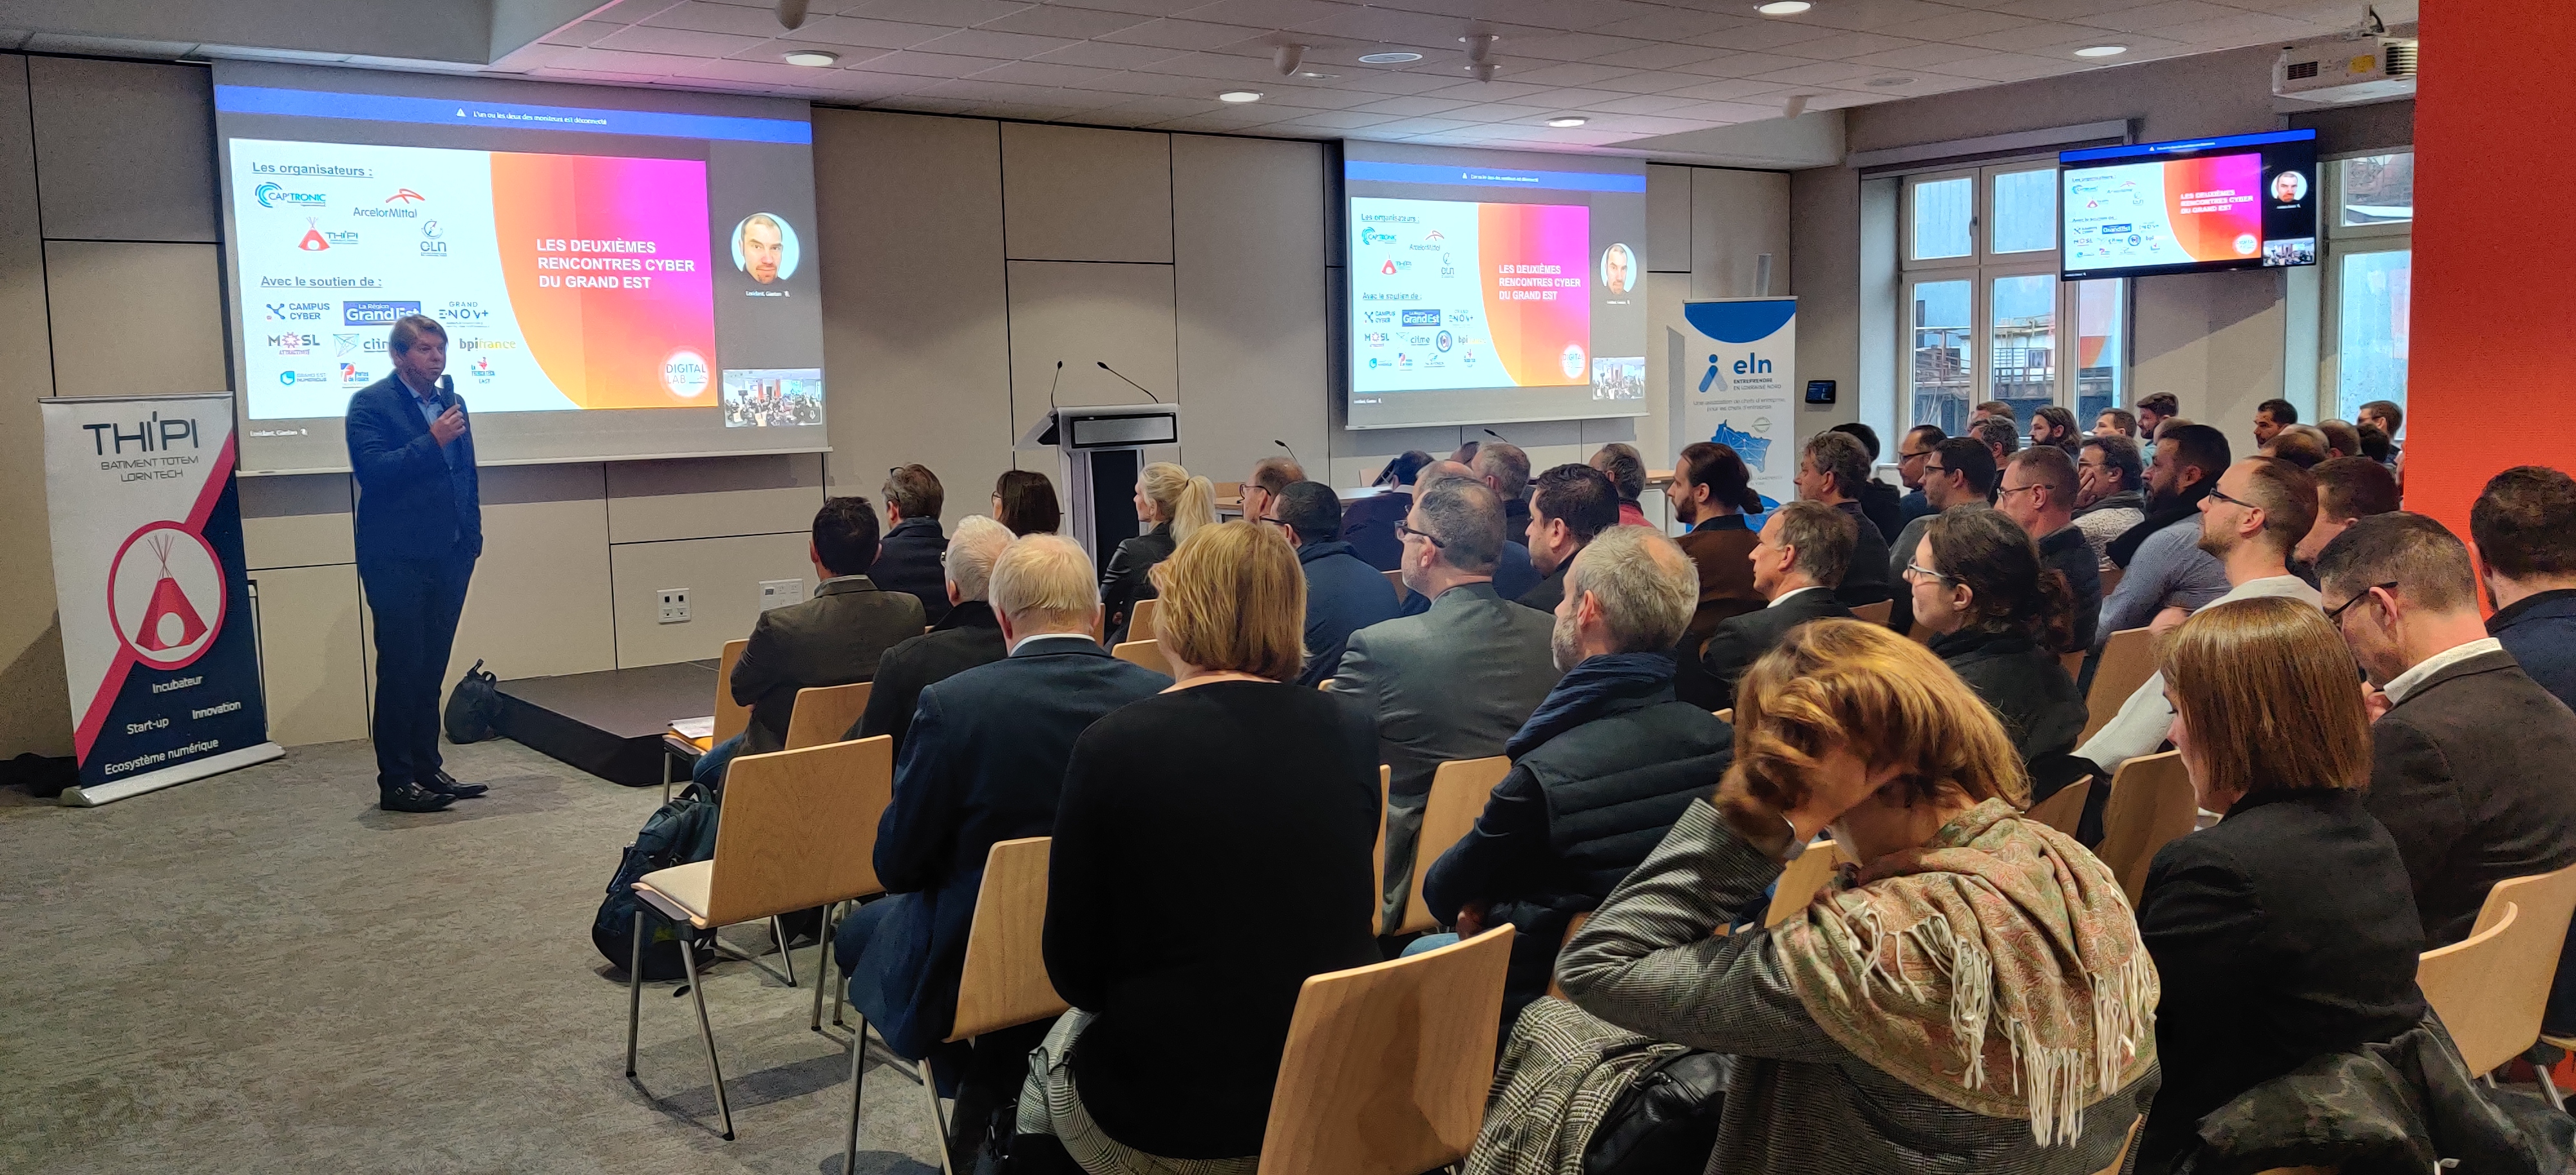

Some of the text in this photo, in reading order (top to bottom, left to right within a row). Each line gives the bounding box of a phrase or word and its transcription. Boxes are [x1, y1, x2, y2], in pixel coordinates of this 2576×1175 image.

[252, 162, 276, 173] Les
[279, 164, 365, 176] organisateurs
[353, 207, 417, 218] ArcelorMittal
[536, 237, 656, 254] LES DEUXIÈMES
[538, 257, 696, 272] RENCONTRES CYBER
[1499, 262, 1562, 275] LES DEUXIÈMES
[260, 276, 292, 286] Avec
[295, 276, 307, 286] le
[309, 276, 355, 286] soutien
[359, 276, 375, 286] de
[538, 275, 652, 289] DU GRAND EST
[1499, 278, 1582, 288] RENCONTRES CYBER
[1499, 291, 1558, 301] DU GRAND EST
[290, 312, 321, 320] CYBER
[346, 307, 395, 321] Grand
[459, 337, 516, 352] bpifrance
[665, 363, 706, 374] DIGITAL
[1733, 352, 1772, 374] eln
[667, 375, 686, 384] LAB
[101, 455, 199, 470] BATIMENT TOTEM
[153, 468, 184, 480] TECH
[152, 676, 203, 694] Incubateur
[192, 701, 242, 720] Innovation
[127, 717, 170, 735] Start-up
[104, 739, 219, 775] Ecosystème numérique
